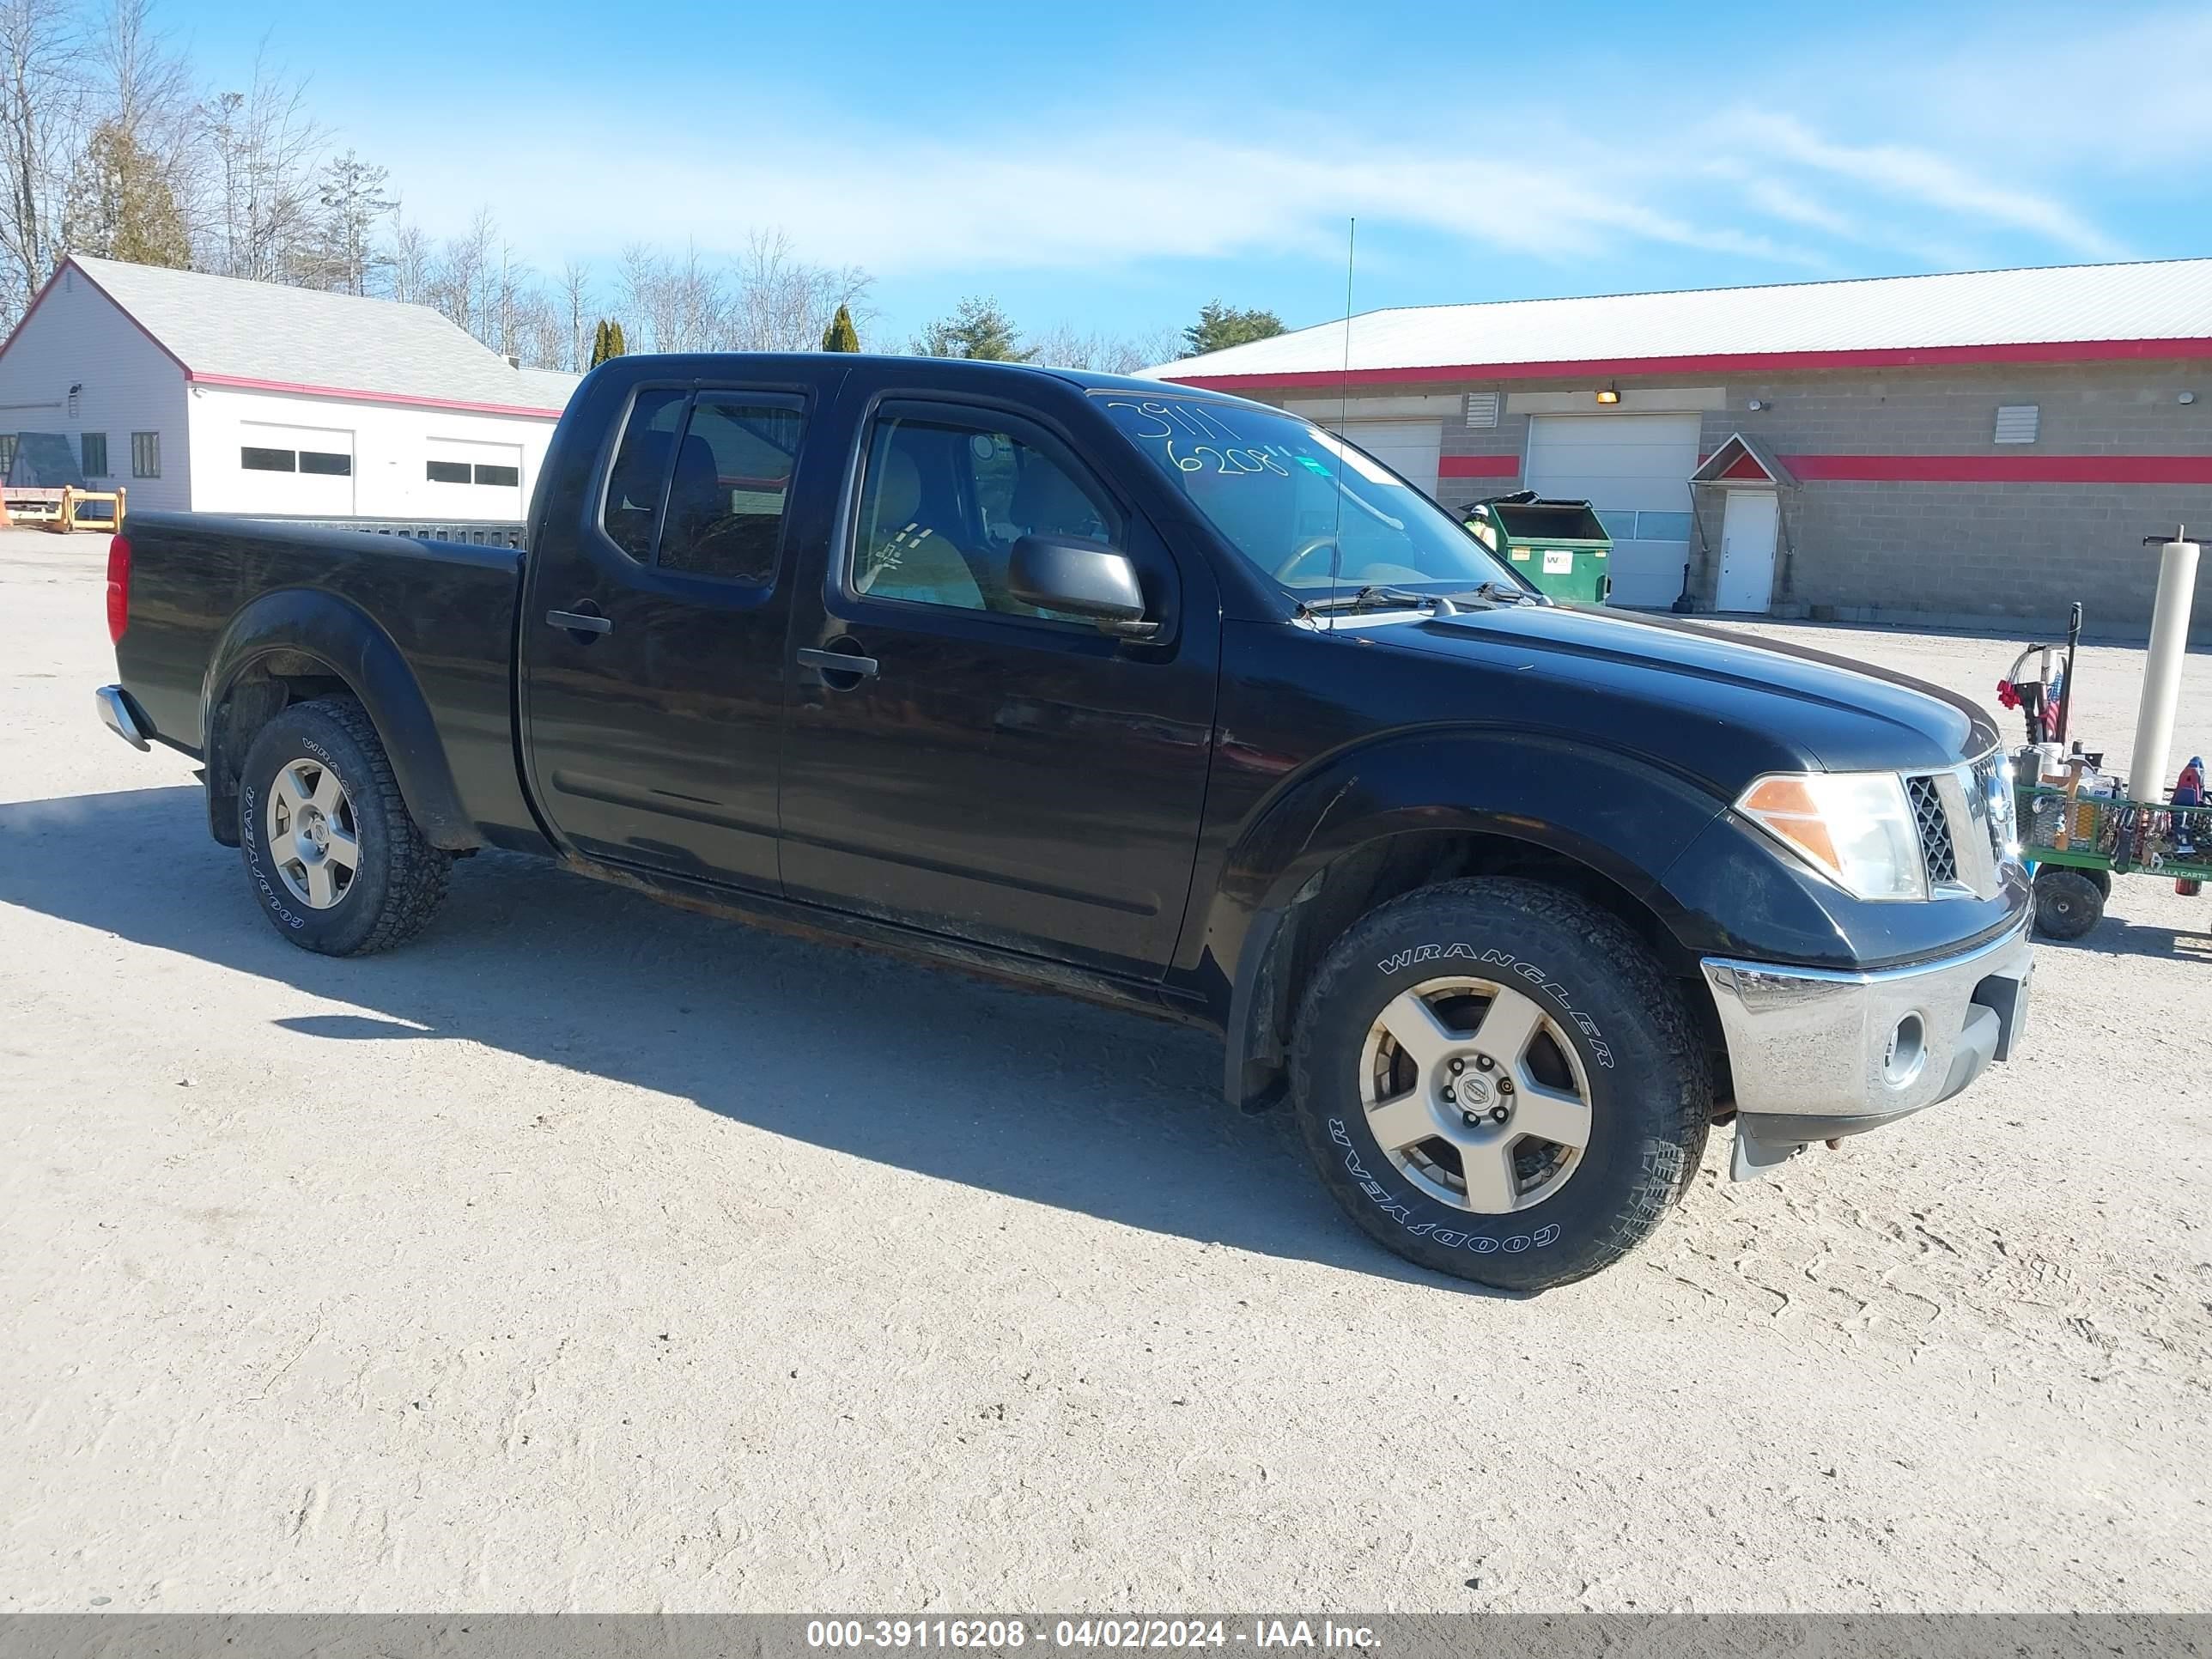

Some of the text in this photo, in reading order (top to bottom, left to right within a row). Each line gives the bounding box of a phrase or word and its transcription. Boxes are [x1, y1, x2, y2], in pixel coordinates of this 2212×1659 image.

[1108, 402, 1243, 441] 3911
[241, 786, 304, 929] GOODYEAR
[1376, 942, 1614, 1070] WRANGLER
[1328, 1118, 1562, 1254] GOODYEAR
